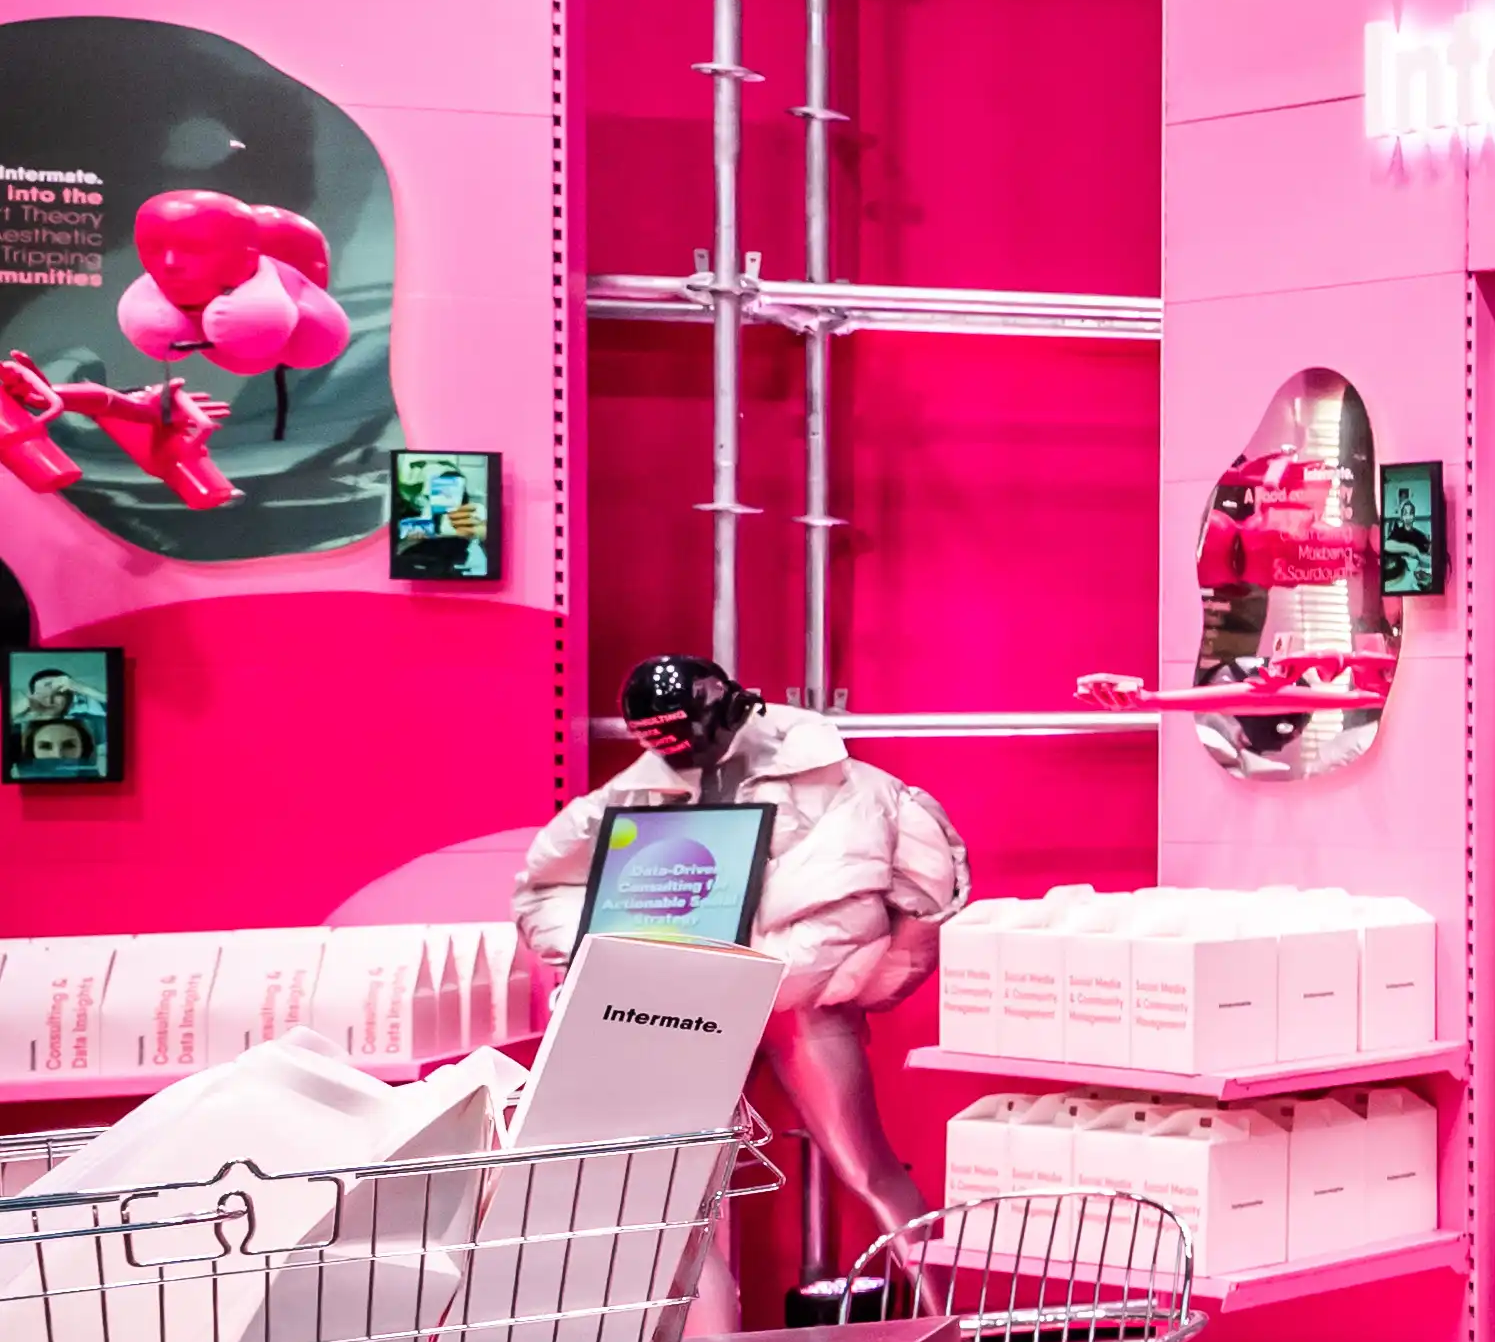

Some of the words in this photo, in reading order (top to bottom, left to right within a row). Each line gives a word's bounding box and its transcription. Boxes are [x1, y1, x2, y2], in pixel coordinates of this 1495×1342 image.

[8, 184, 56, 203] Into
[63, 187, 104, 205] the
[21, 205, 104, 230] Theory
[0, 228, 103, 247] esthetic
[2, 245, 102, 271] Tripping
[0, 267, 103, 288] munities
[260, 983, 282, 1041] nsulting
[602, 1004, 723, 1034] Intermate.
